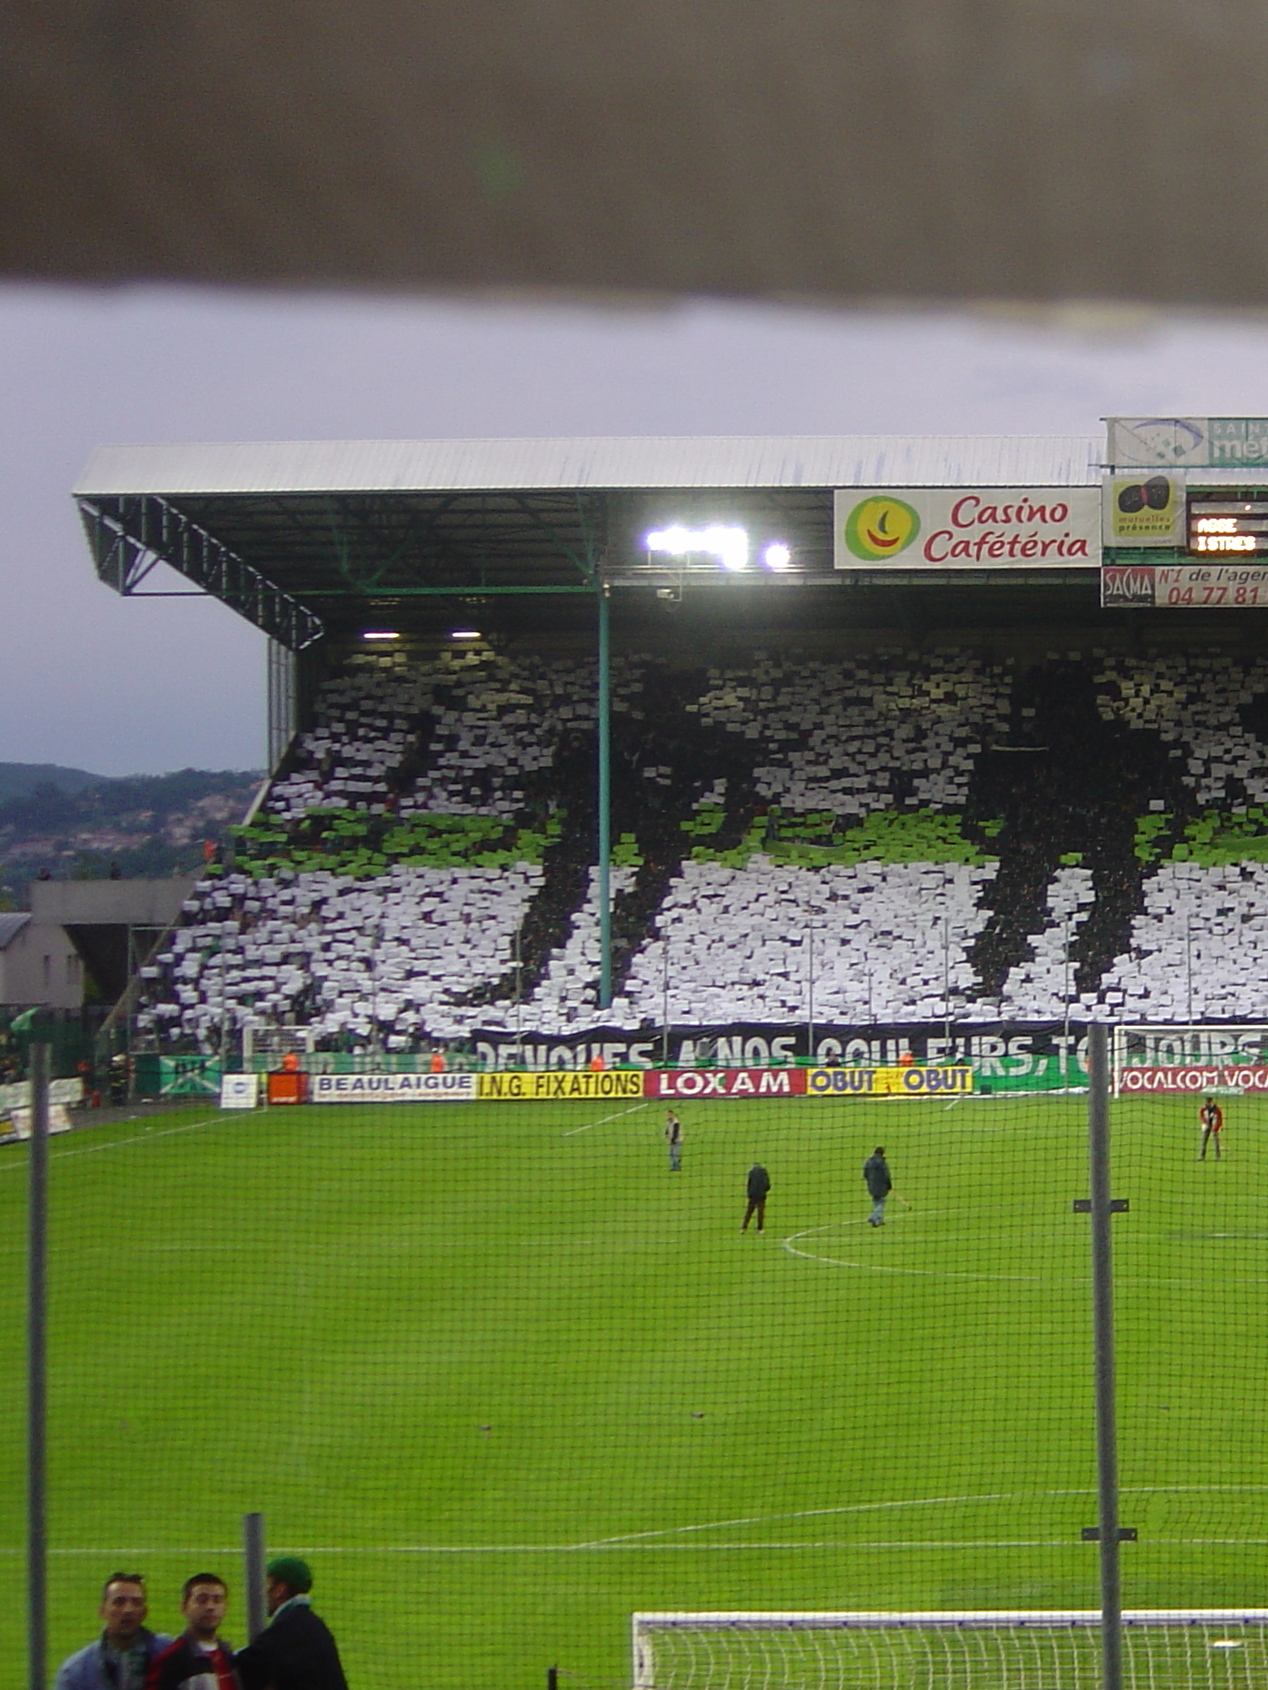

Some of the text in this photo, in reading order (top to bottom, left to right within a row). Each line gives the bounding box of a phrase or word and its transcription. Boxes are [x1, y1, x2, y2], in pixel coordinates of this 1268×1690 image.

[951, 495, 1068, 528] Casino
[1119, 515, 1170, 523] mutuelles
[1119, 524, 1171, 532] présence
[923, 530, 1088, 562] Cafétéria
[1105, 567, 1152, 598] SACMA
[1189, 568, 1212, 583] de
[1168, 587, 1194, 605] 04
[1203, 587, 1229, 604] 77
[1235, 586, 1260, 604] 81
[717, 1036, 796, 1069] NOS
[319, 1075, 472, 1091] BEAULAIGUE
[535, 1073, 640, 1097] FIXATIONS
[659, 1071, 791, 1095] LOXAM
[811, 1070, 877, 1092] OBUT
[904, 1069, 969, 1091] OBUT
[1118, 1071, 1218, 1089] VOCALCOM
